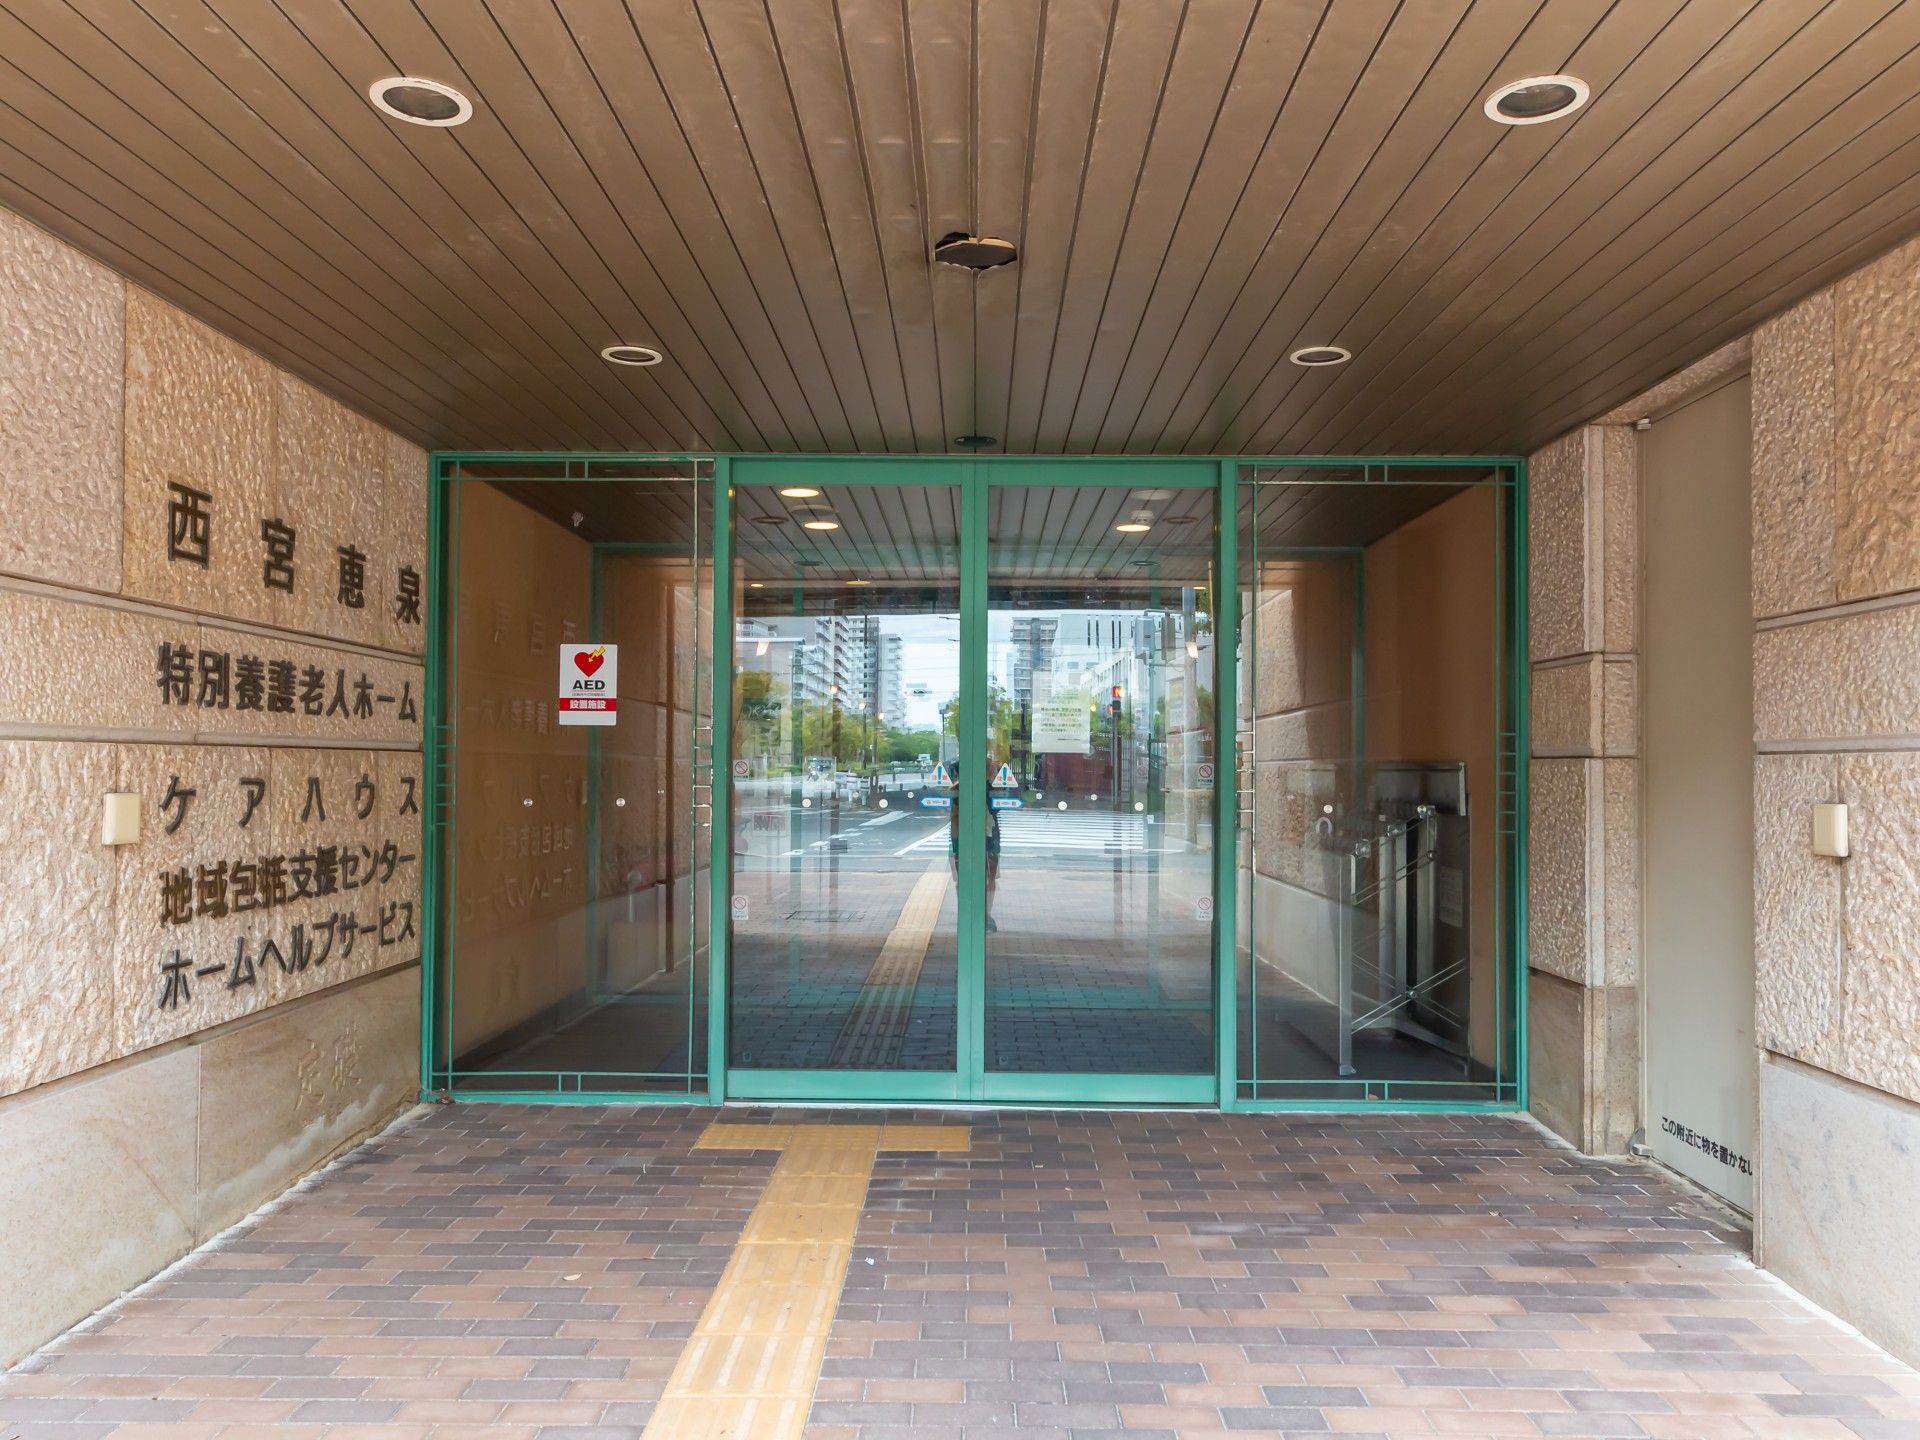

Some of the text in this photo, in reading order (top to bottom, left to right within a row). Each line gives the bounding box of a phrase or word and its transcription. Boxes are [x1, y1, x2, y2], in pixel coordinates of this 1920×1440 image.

[167, 480, 420, 625] 西宮恵泉
[157, 641, 417, 723] 特別養護老人ホーム
[572, 680, 605, 689] AED
[159, 774, 418, 835] ケアハウス
[159, 839, 416, 928] 地域包括支援センター
[158, 901, 416, 1009] ホームヘルプサービス
